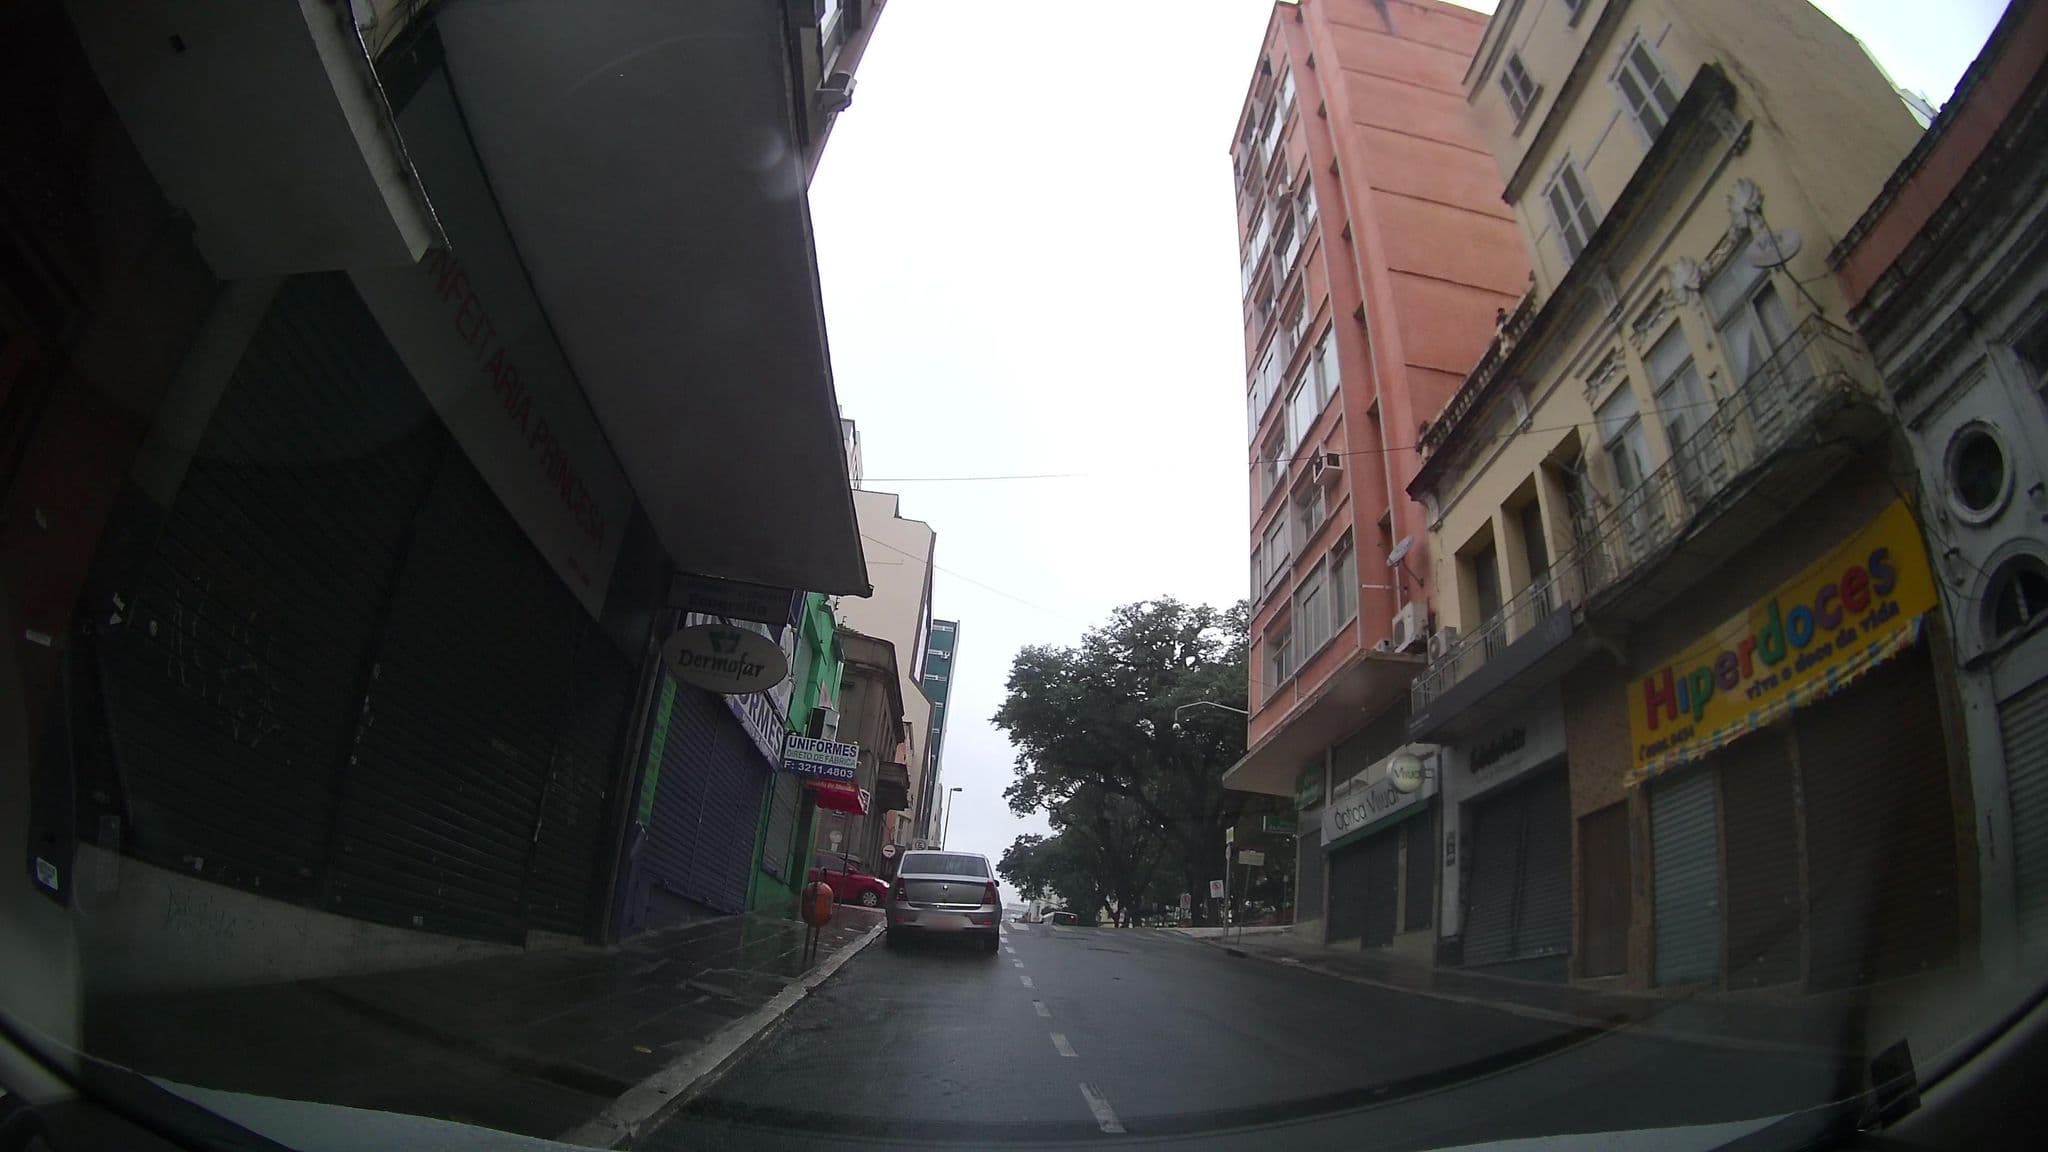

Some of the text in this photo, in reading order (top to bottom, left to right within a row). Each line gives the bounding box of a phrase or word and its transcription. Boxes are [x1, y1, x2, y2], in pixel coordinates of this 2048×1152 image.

[428, 248, 535, 434] NFEITARIA
[1643, 547, 1895, 730] Hiperdoces
[678, 649, 766, 681] Dermofar
[787, 749, 813, 760] DIRETO
[813, 753, 824, 762] DE
[789, 736, 857, 758] UNIFORMES
[798, 760, 854, 779] 3211.4803
